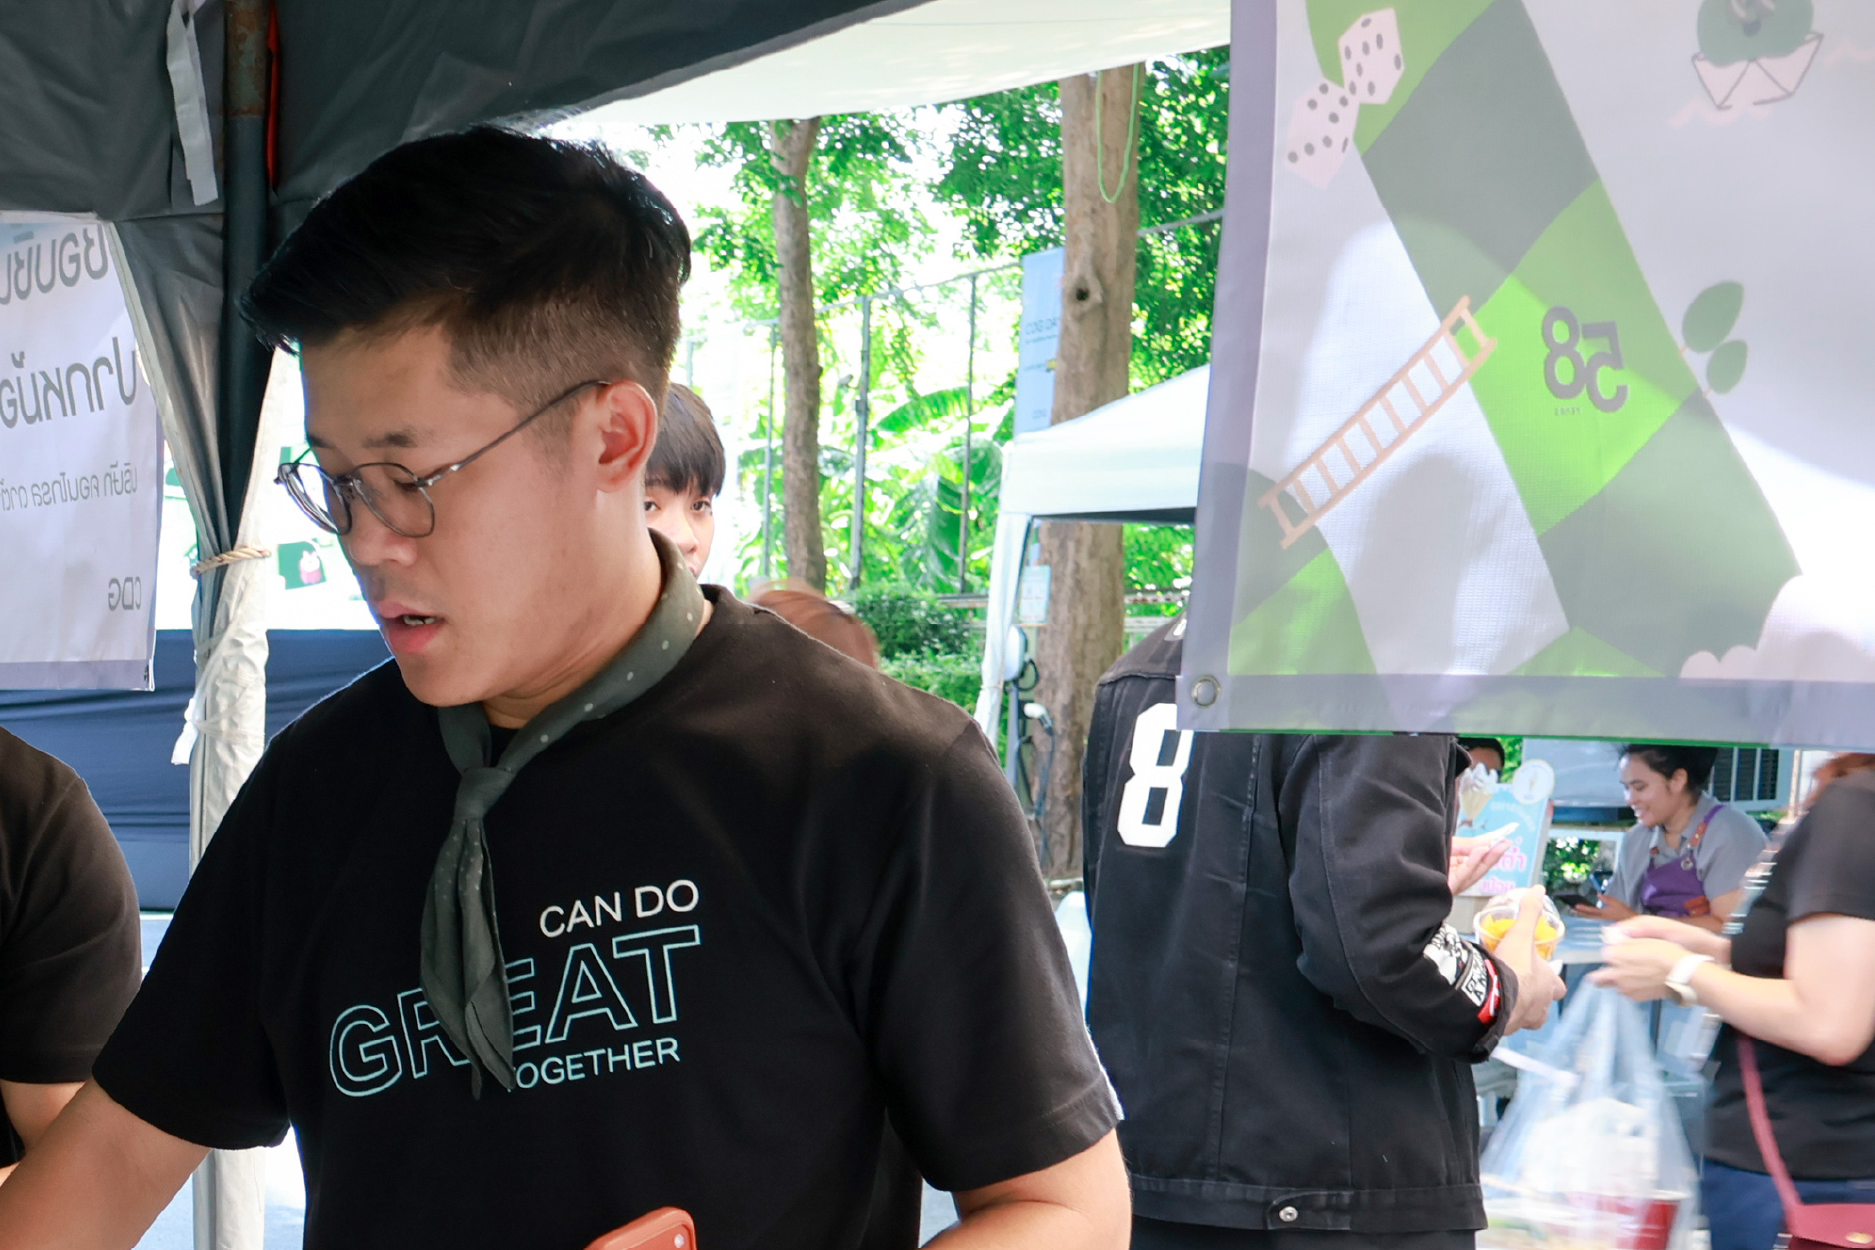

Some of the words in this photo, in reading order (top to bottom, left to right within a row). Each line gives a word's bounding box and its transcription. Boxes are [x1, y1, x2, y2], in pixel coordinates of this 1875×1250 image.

[540, 892, 622, 938] CAN
[634, 879, 700, 919] DO
[511, 1037, 680, 1090] OGETHER
